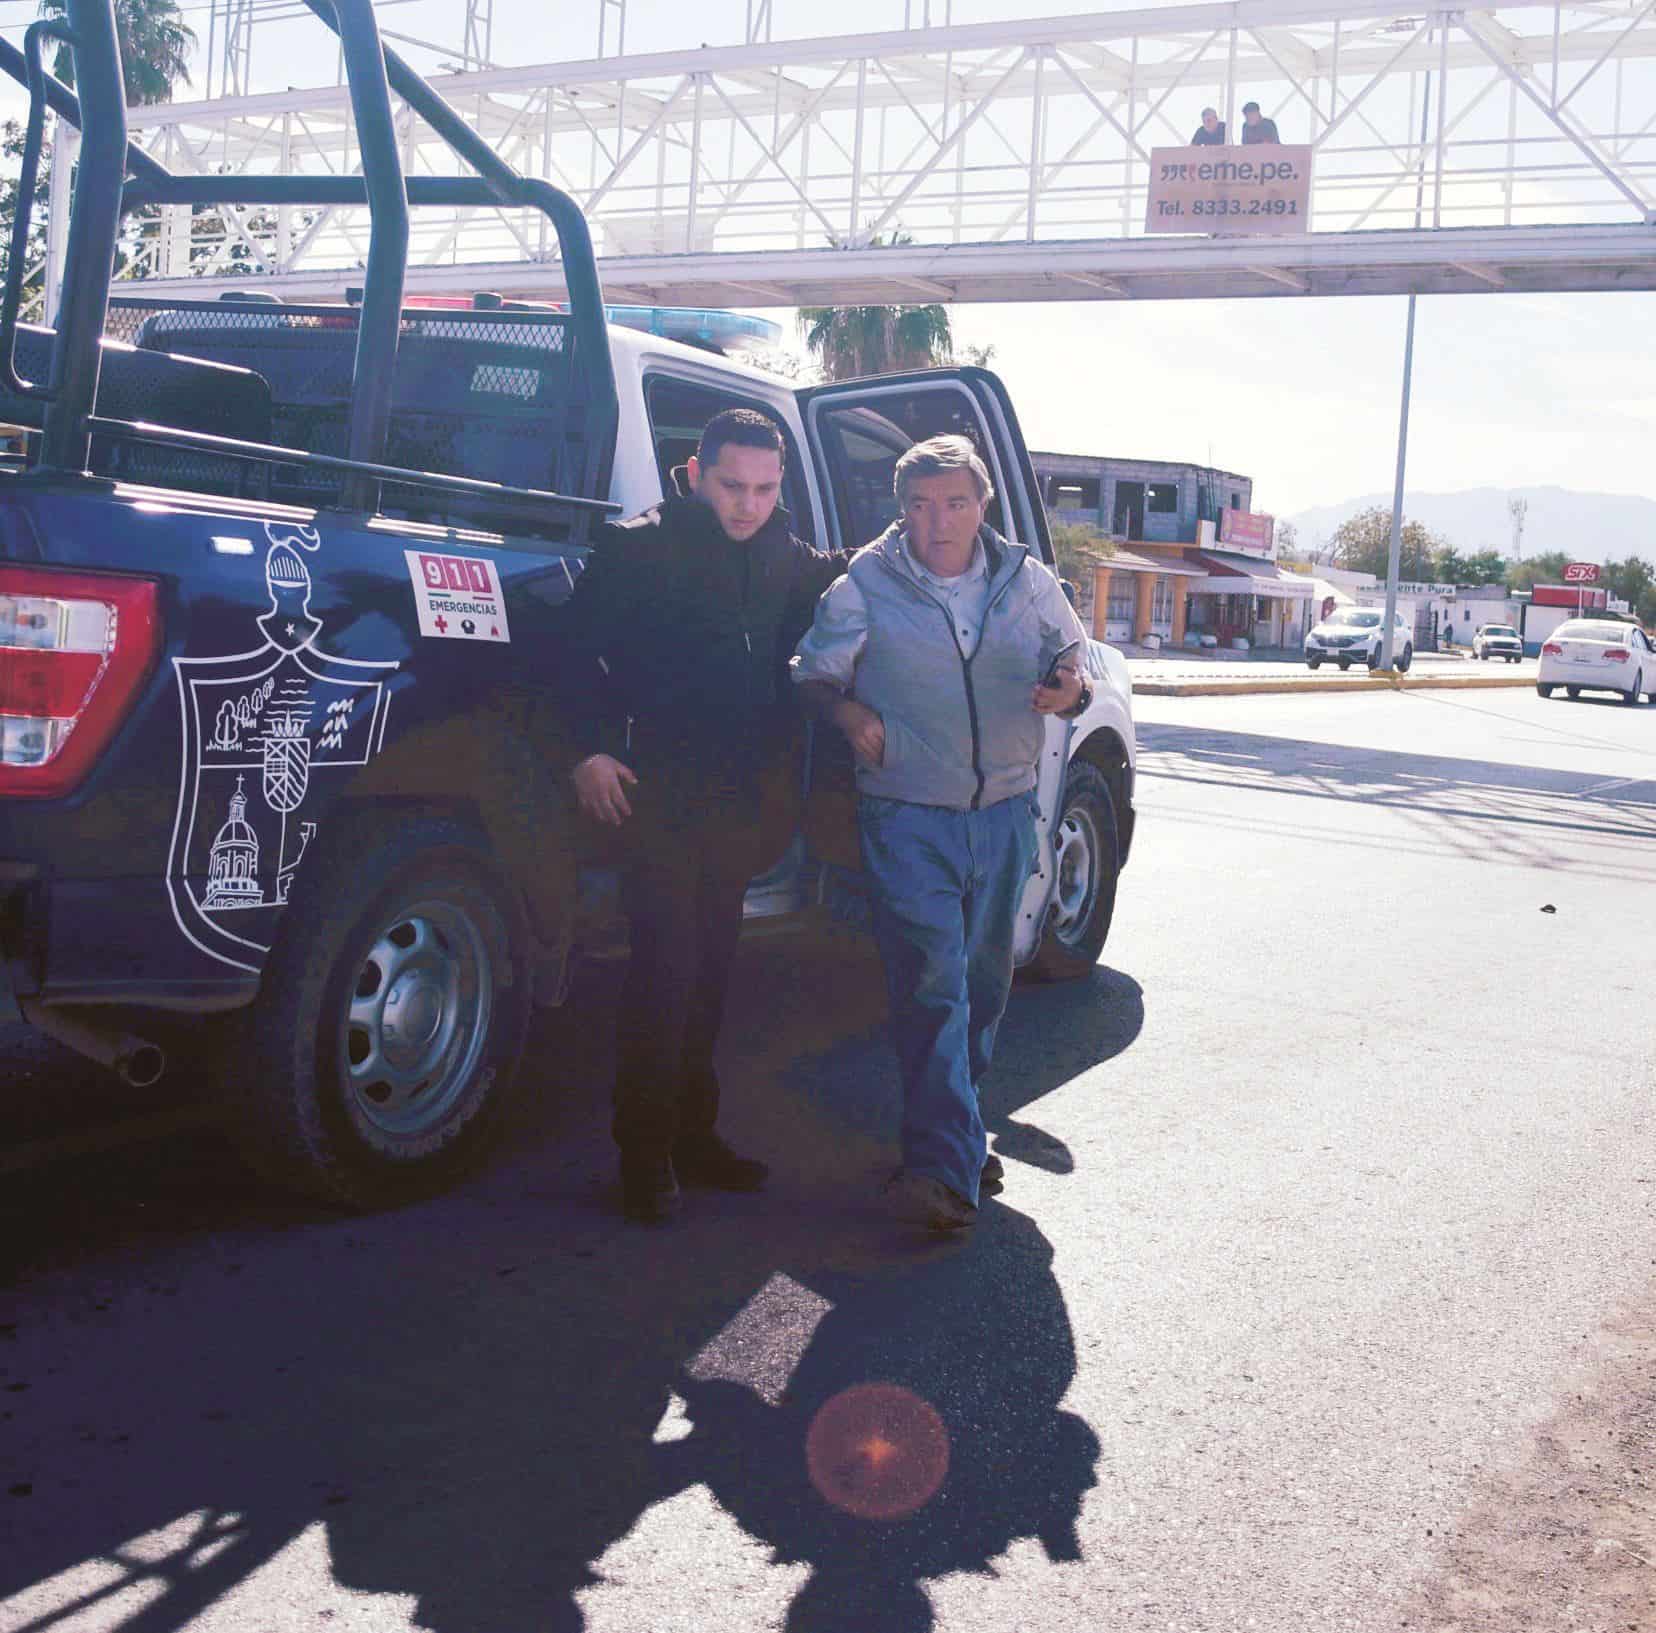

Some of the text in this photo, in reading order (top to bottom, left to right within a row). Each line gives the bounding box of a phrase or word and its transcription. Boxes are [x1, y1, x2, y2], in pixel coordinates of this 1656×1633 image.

[1157, 199, 1298, 216] Tel. 8333.2491
[424, 559, 487, 590] 911
[429, 600, 498, 616] EMERGENCIAS
